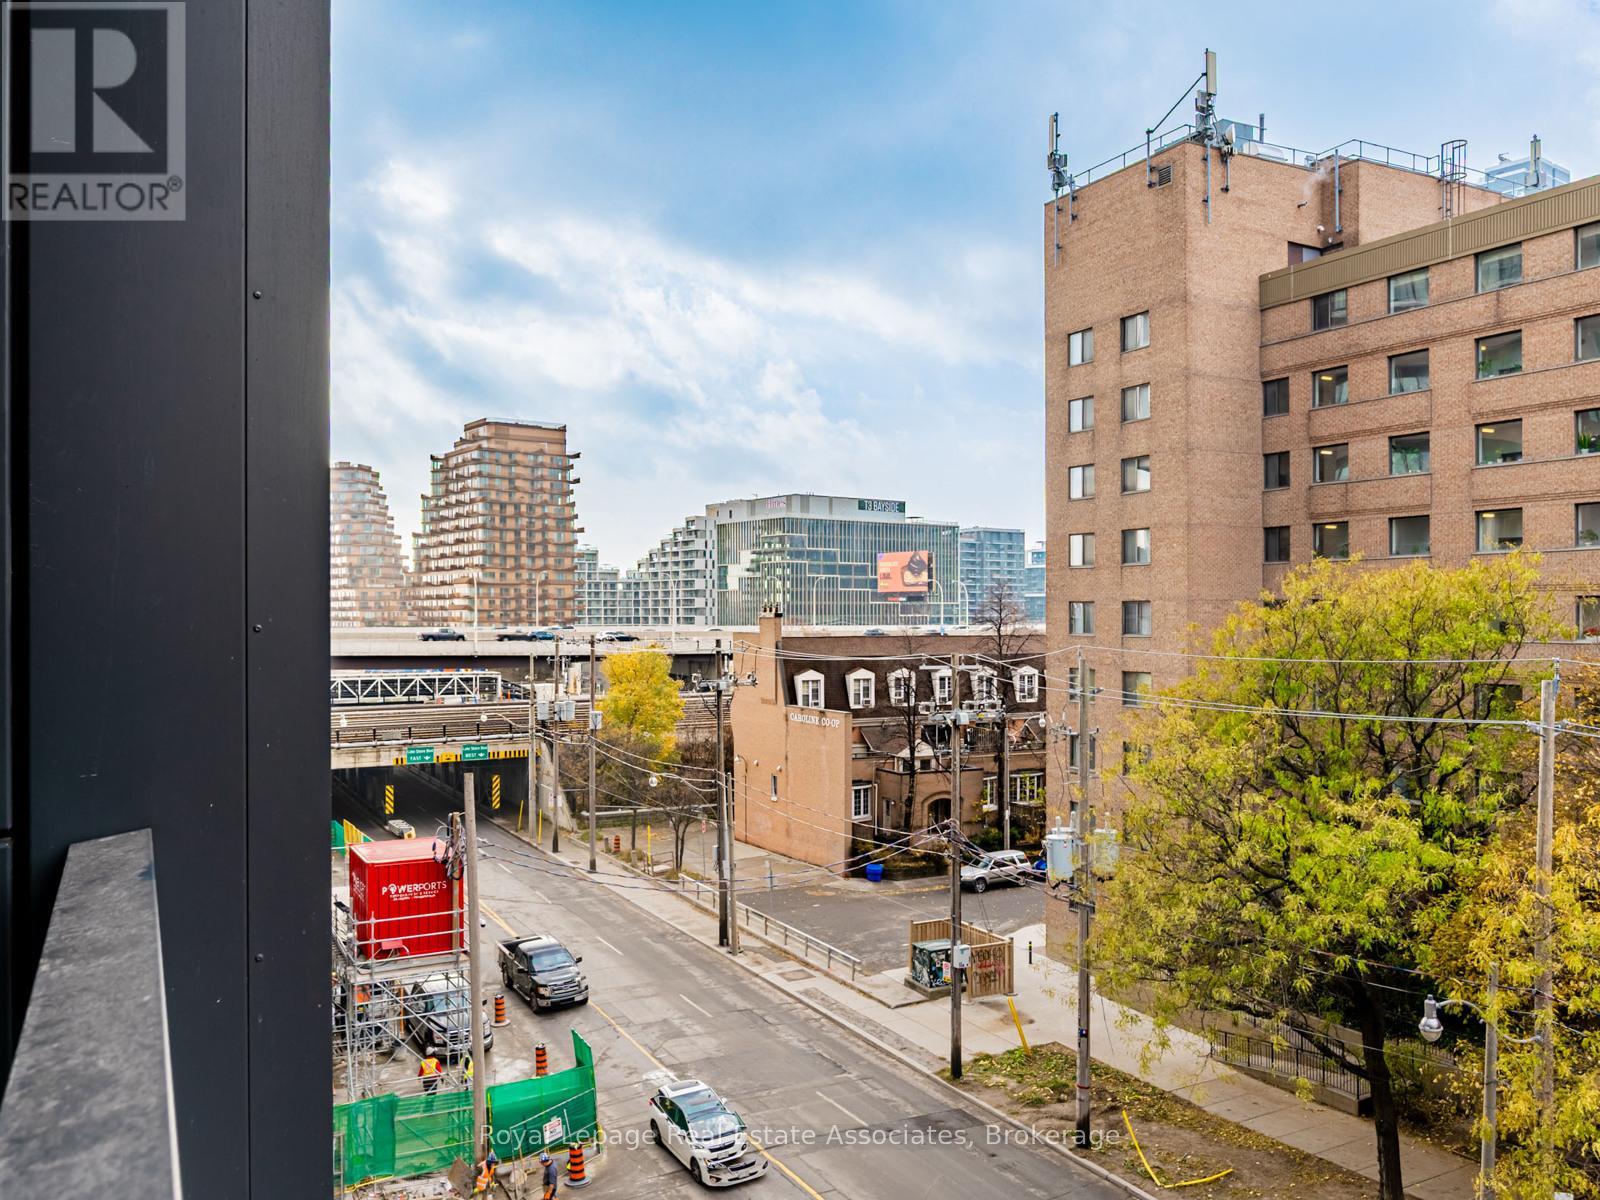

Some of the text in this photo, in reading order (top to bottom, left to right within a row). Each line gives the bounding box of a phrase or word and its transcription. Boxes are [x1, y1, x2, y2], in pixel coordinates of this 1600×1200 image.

[864, 500, 900, 513] T3 BAYSIDE
[790, 712, 840, 728] CAROLINE CO-OP
[381, 880, 448, 896] POWERPORTS
